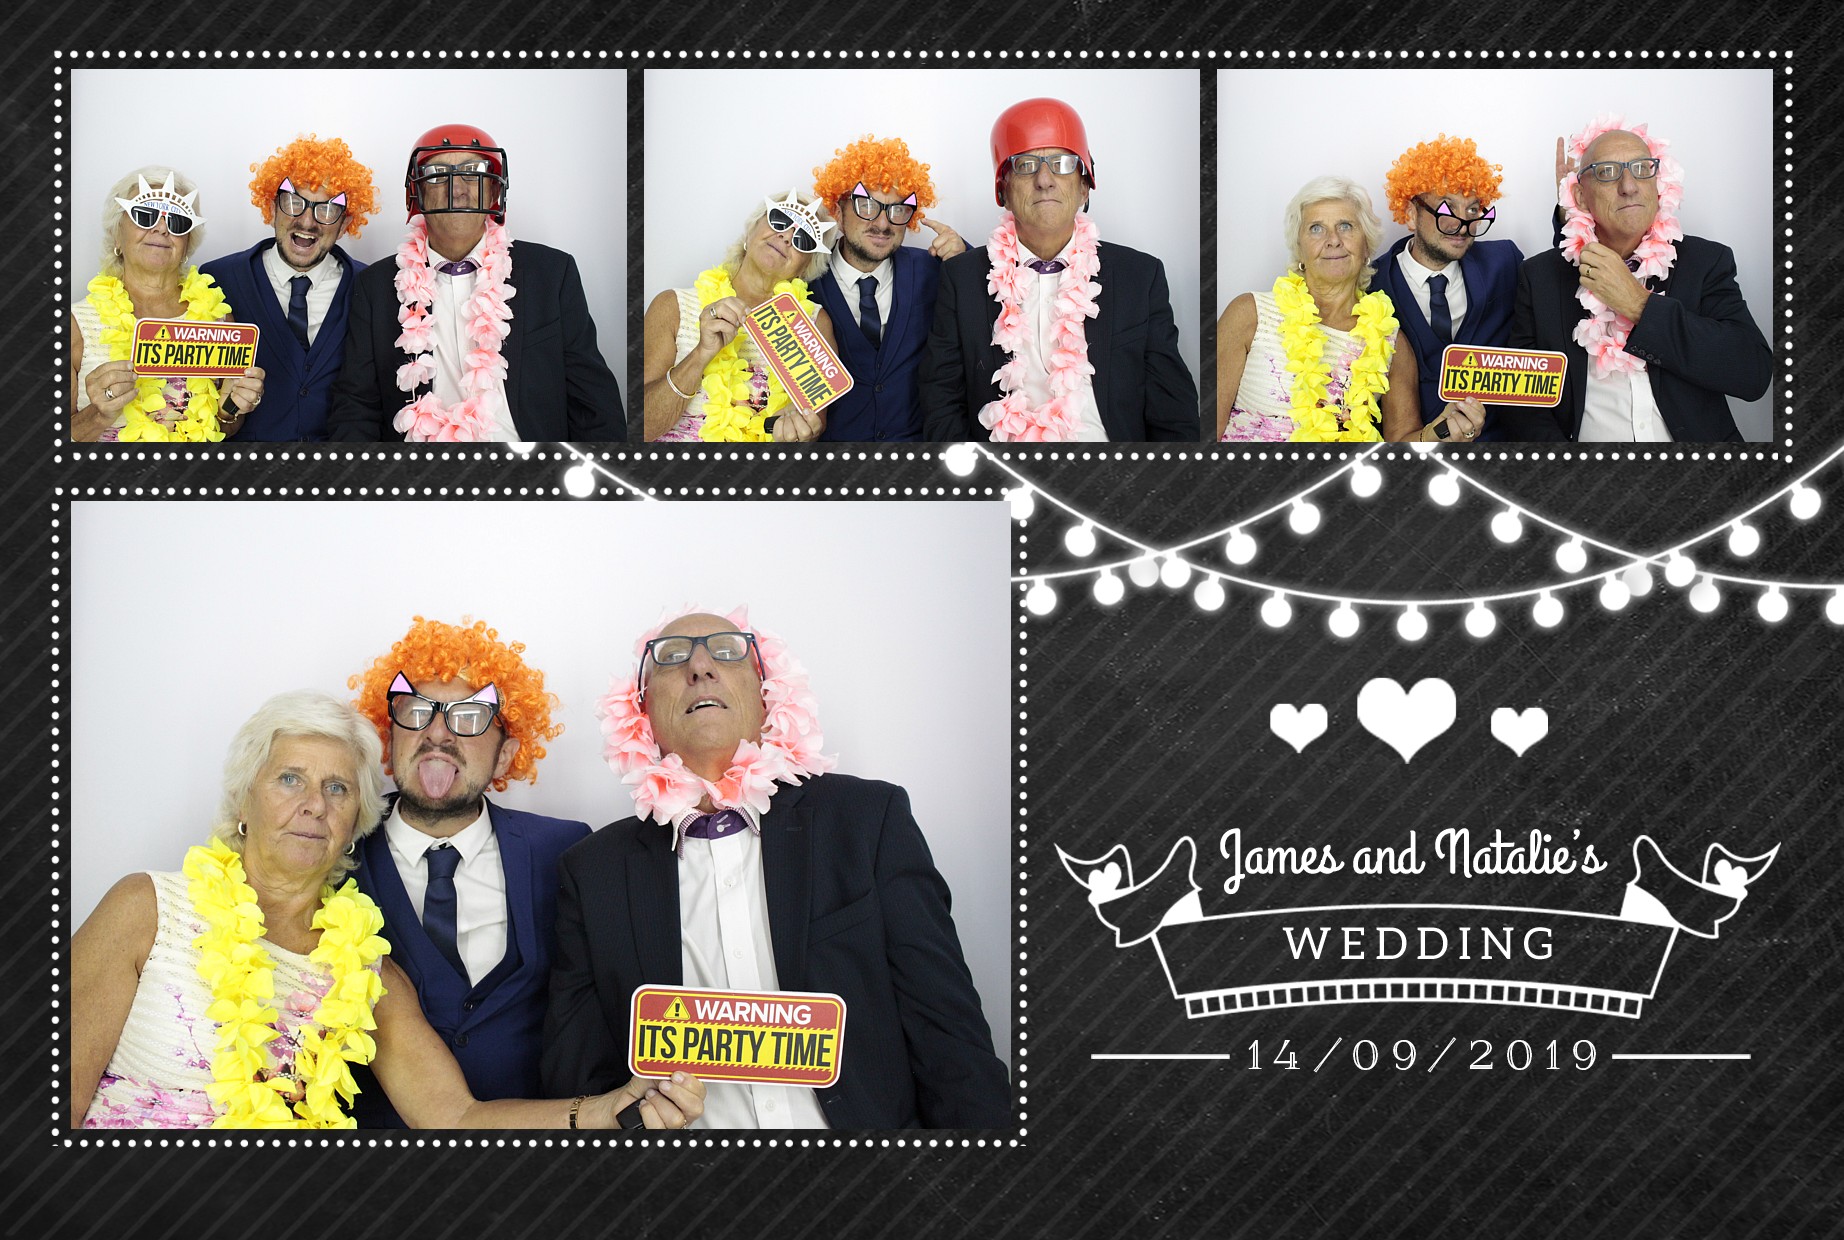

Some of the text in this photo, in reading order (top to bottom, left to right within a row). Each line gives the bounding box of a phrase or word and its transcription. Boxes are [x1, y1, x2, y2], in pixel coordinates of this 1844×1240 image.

[174, 326, 241, 342] WARNING
[136, 342, 252, 366] ITS PARTY TIME
[753, 304, 833, 407] ITS PARTY TIME
[793, 319, 839, 379] WARNING
[1481, 353, 1549, 371] WARNING
[1445, 368, 1559, 395] ITS PARTY TIME
[695, 999, 812, 1024] WARNING
[638, 1024, 834, 1067] ITS PARTY TIME
